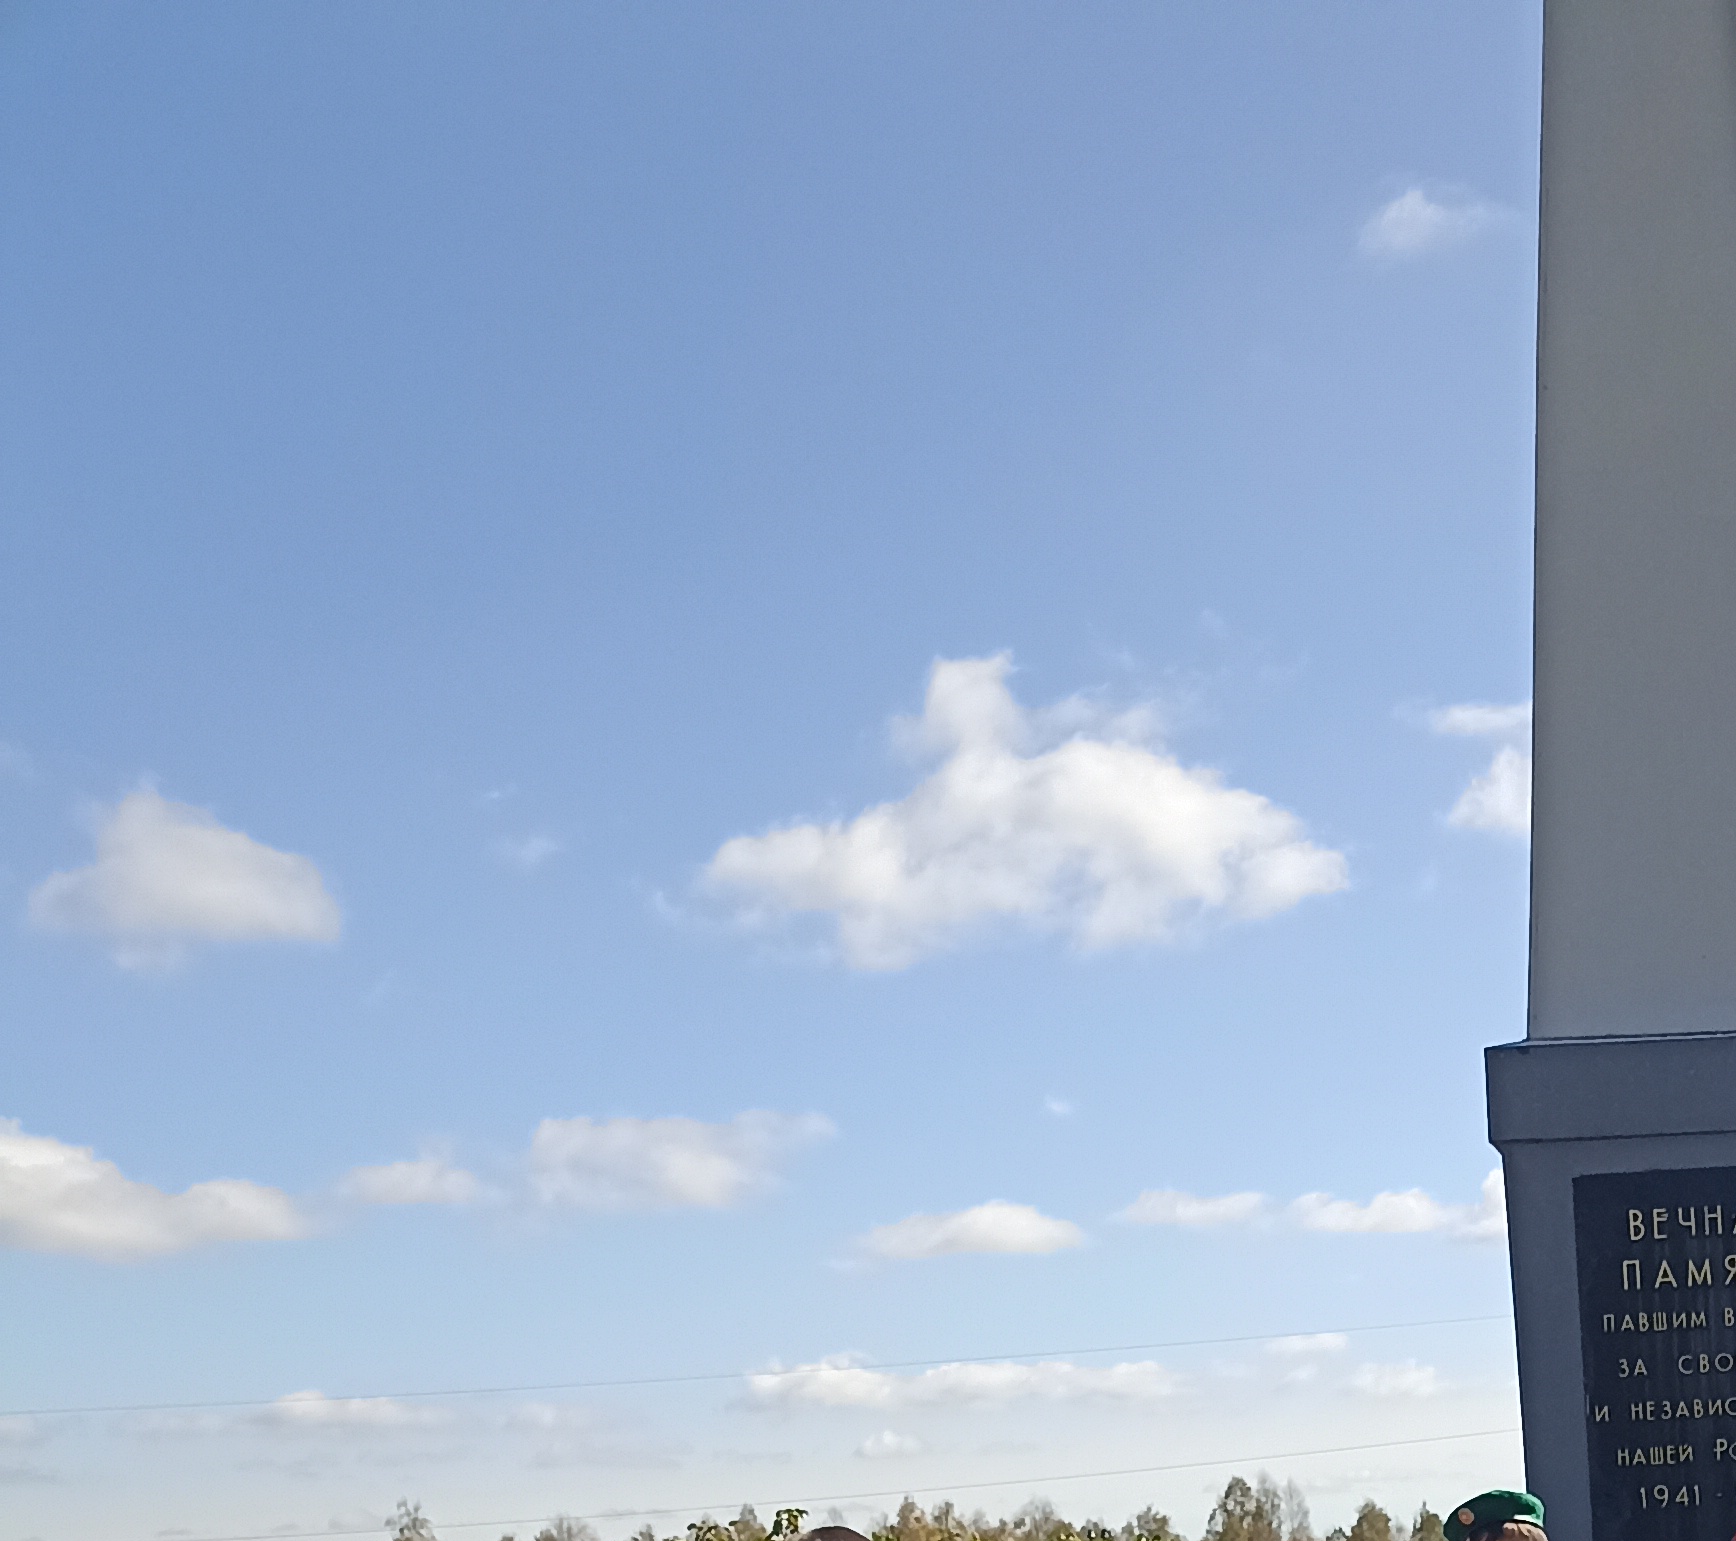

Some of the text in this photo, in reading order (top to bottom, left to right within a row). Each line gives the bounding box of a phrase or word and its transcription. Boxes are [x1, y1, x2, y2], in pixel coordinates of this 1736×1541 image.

[1603, 1311, 1707, 1333] ПАВШИМ
[1724, 1307, 1735, 1327] В
[1618, 1358, 1648, 1378] ЗА
[1594, 1405, 1610, 1422] И
[1617, 1444, 1694, 1467] НАШЕЙ
[1640, 1484, 1700, 1509] 1941
